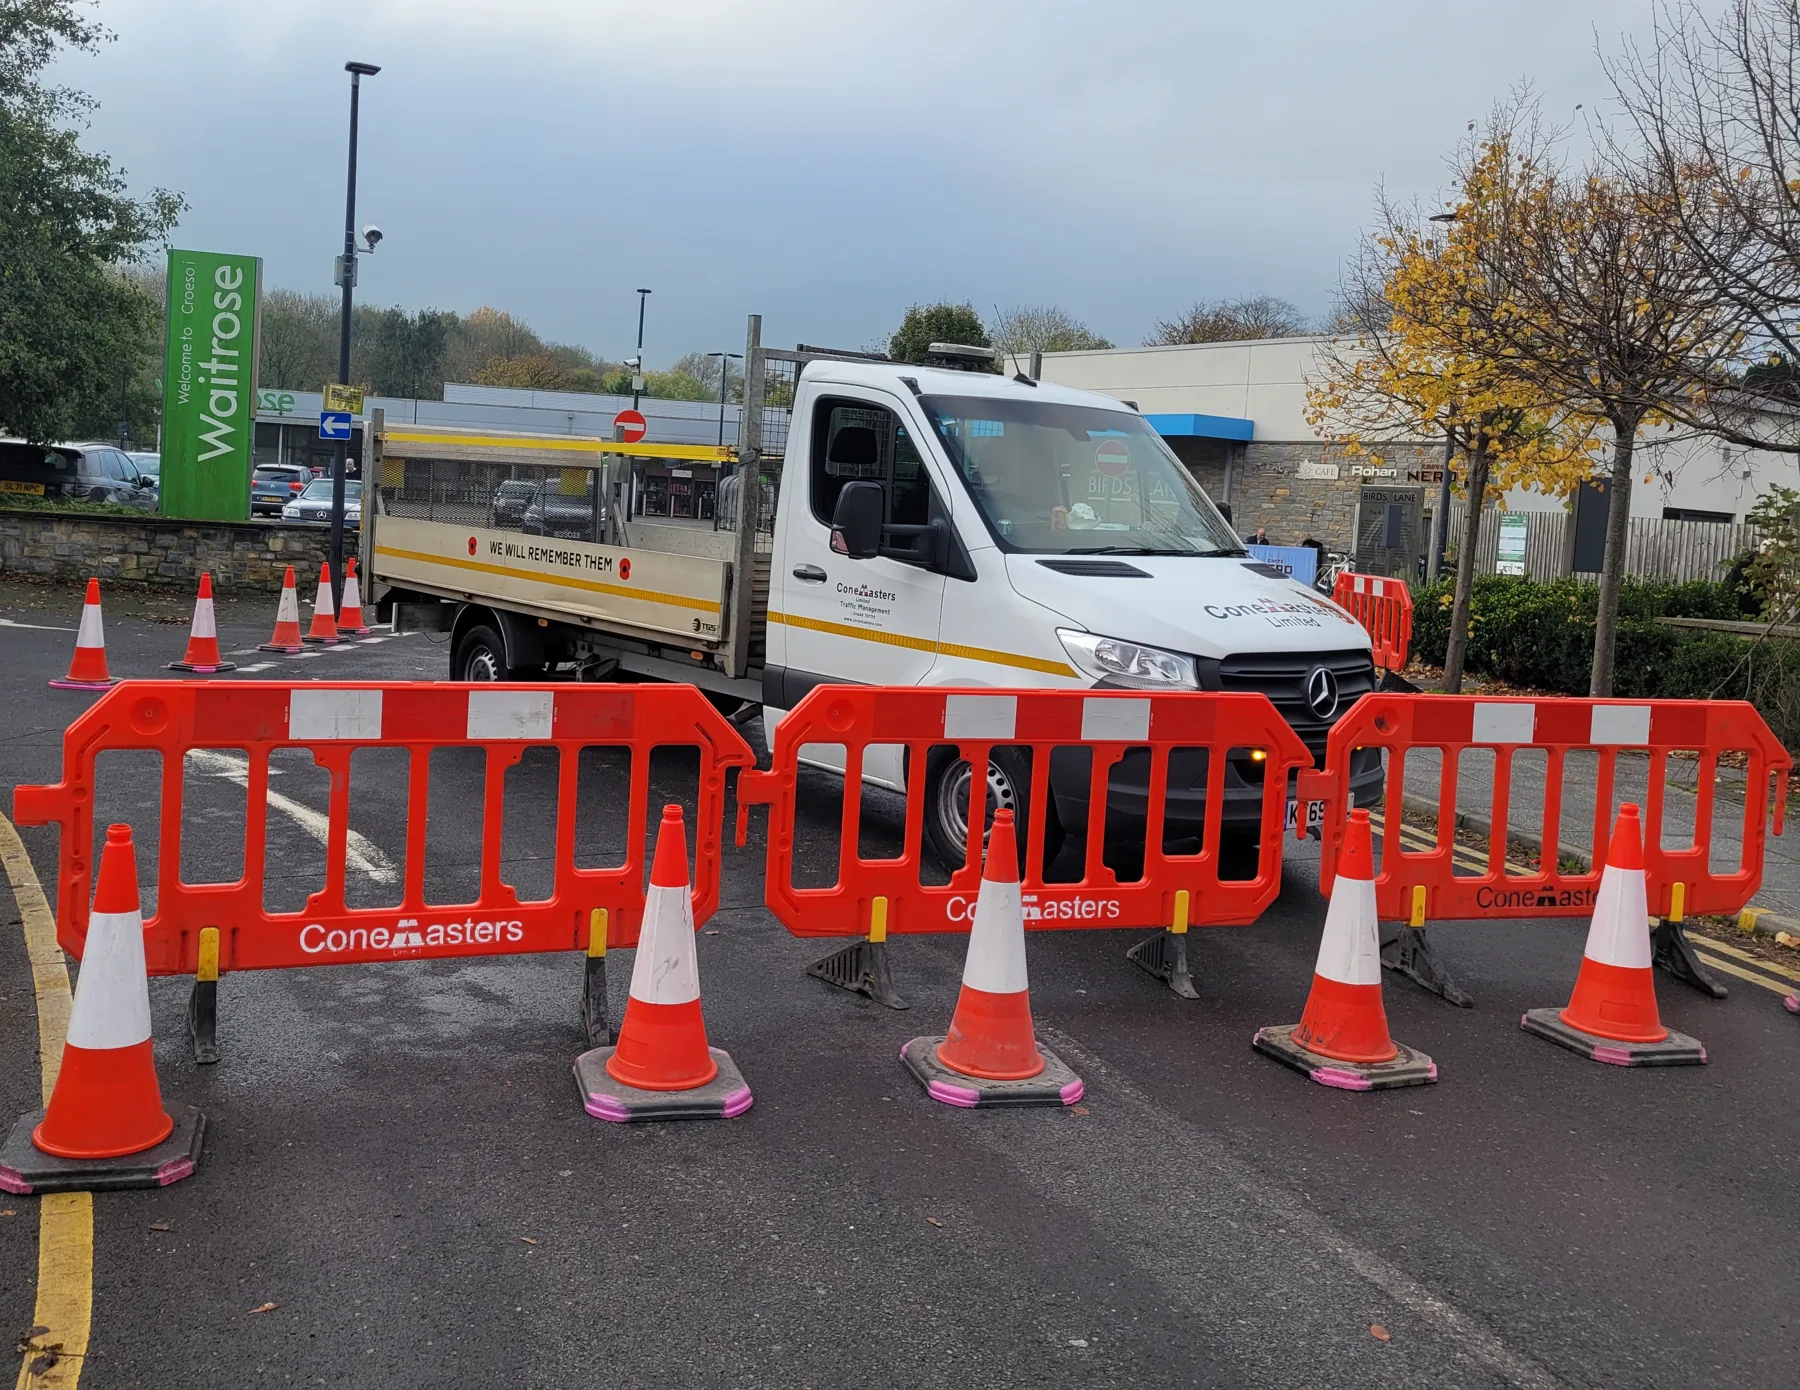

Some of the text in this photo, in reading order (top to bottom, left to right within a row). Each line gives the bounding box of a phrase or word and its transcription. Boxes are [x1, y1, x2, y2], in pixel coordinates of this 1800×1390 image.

[181, 267, 195, 314] Croeso
[180, 327, 193, 341] to
[197, 265, 243, 462] Waitrose
[177, 344, 192, 405] Welcome
[1315, 467, 1336, 476] CAFE
[1351, 465, 1397, 477] Rohan
[4, 482, 22, 491] SL71
[1363, 492, 1416, 502] BIRDS LANE
[489, 540, 613, 572] WE WILL REMEMBER THEM
[836, 582, 896, 601] ConeMasters
[840, 600, 857, 610] Traffic
[857, 603, 891, 616] Management
[701, 622, 717, 632] TGS
[1266, 617, 1322, 628] Limited
[299, 916, 523, 953] ConeMasters
